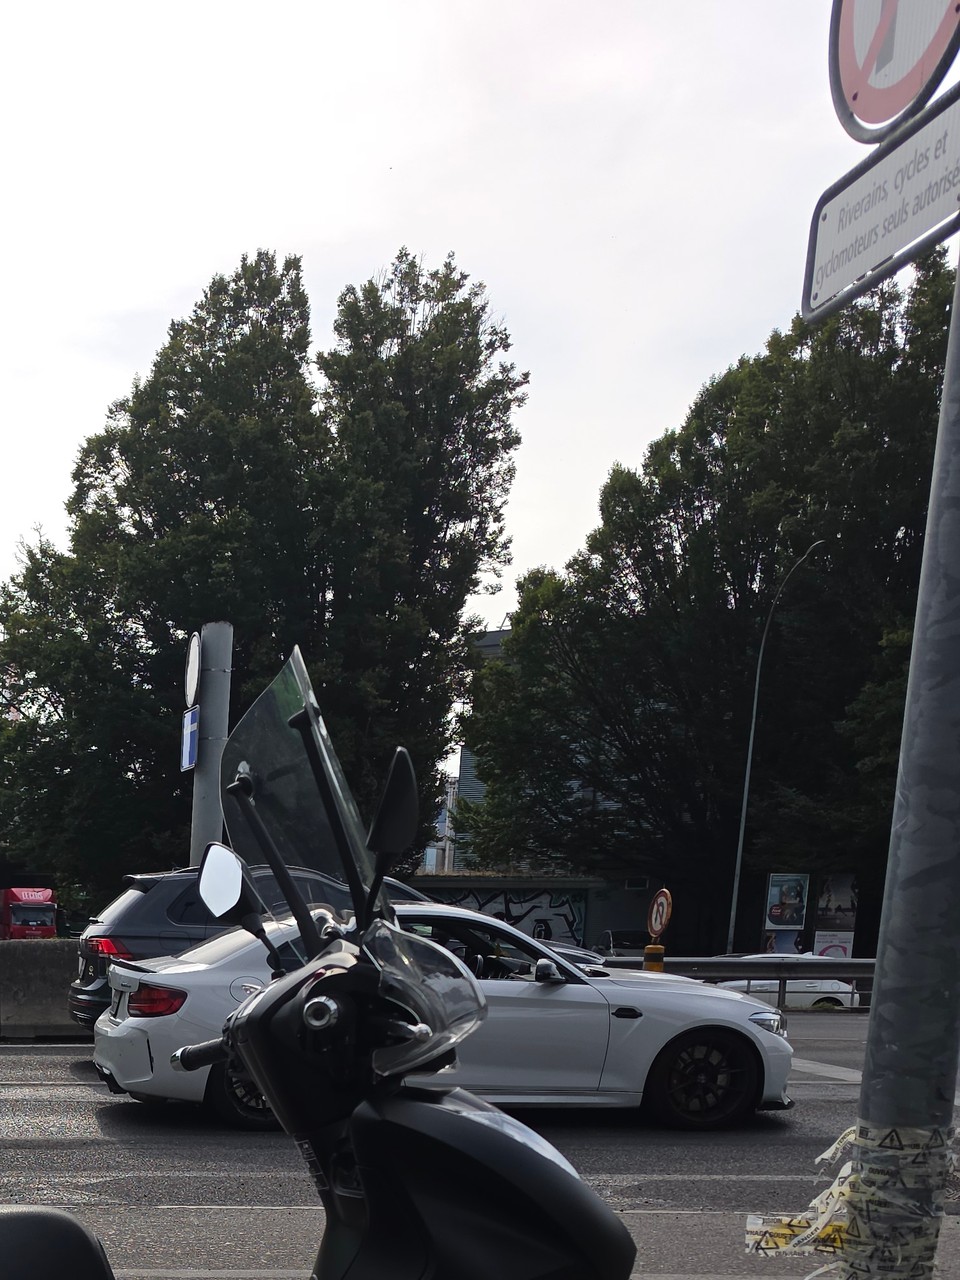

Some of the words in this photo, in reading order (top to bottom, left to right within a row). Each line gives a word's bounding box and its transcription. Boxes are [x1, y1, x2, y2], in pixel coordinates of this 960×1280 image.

[894, 146, 930, 195] cycles
[934, 129, 948, 161] et
[815, 223, 880, 289] cyclomoteurs
[881, 199, 910, 238] seuls
[792, 1226, 820, 1248] DANGER
